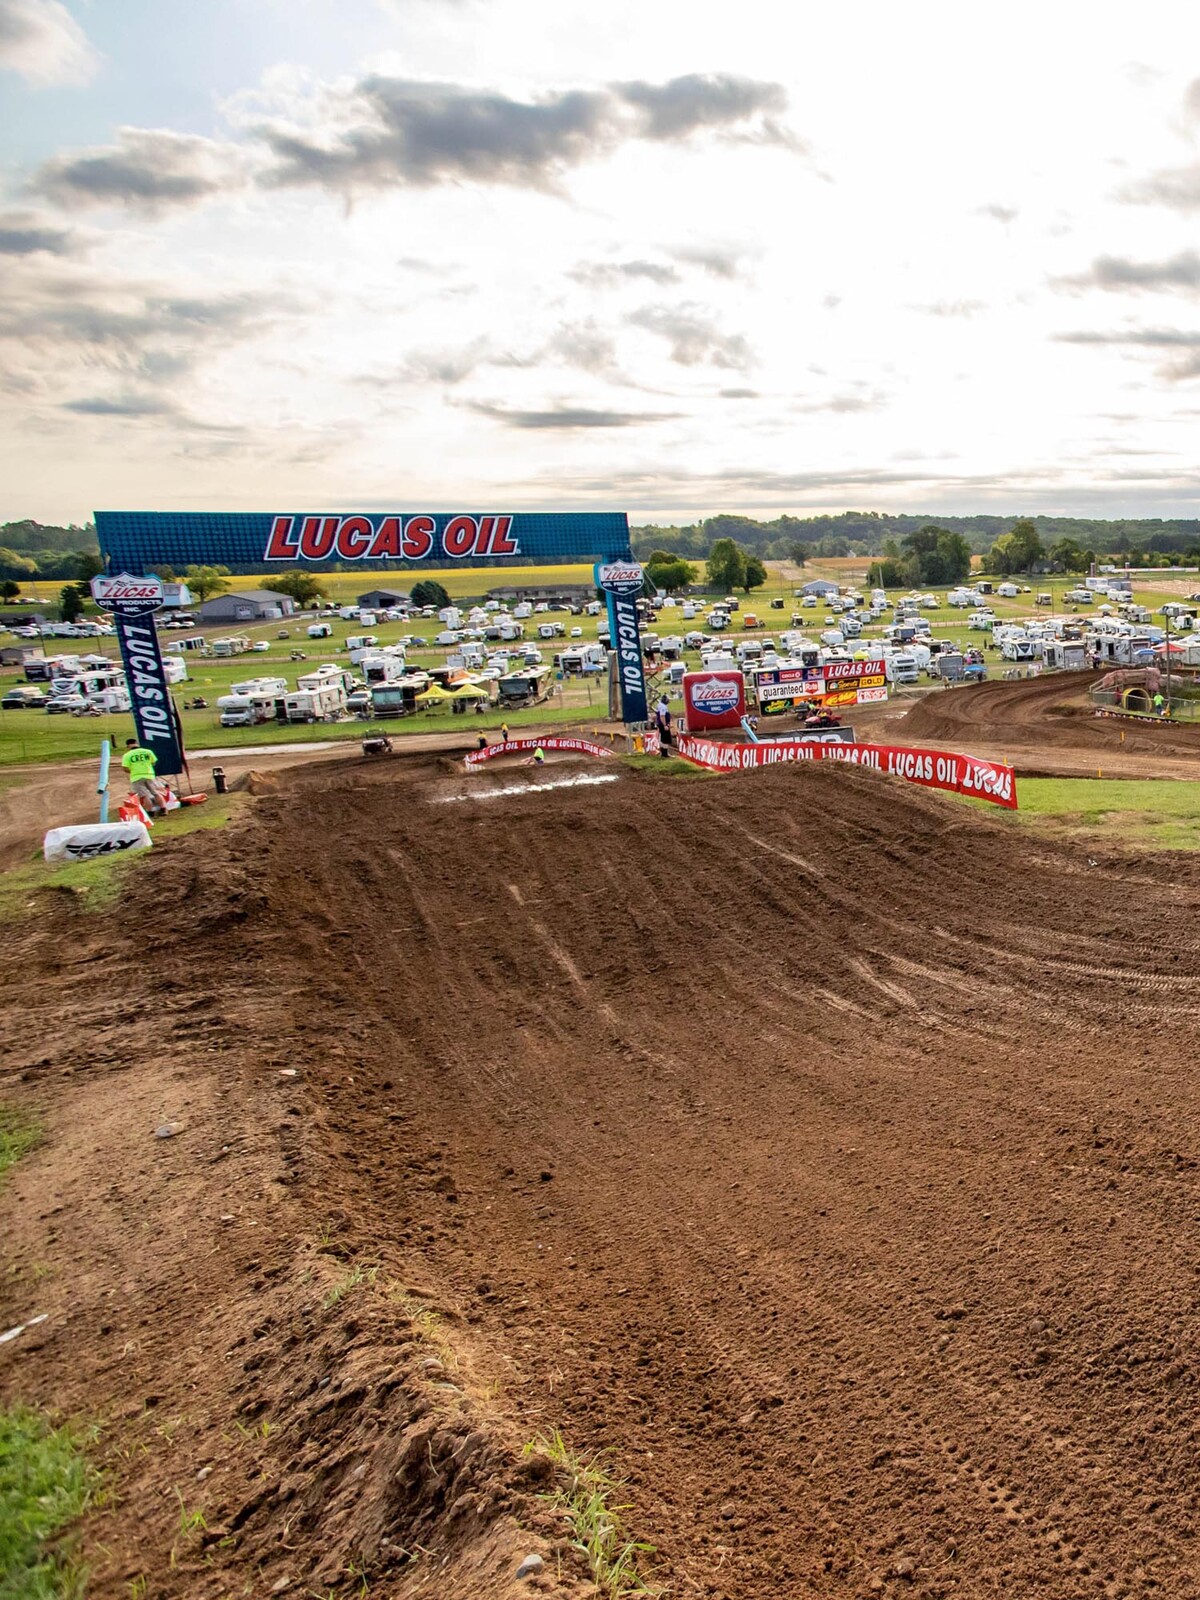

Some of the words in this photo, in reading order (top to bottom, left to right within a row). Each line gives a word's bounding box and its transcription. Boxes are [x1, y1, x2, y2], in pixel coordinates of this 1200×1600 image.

[264, 516, 436, 560] LUCAS
[442, 515, 518, 557] OIL
[605, 570, 640, 580] LUCAS
[103, 587, 159, 598] LUCAS
[616, 601, 640, 662] LUCAS
[123, 625, 164, 701] LUCAS
[828, 664, 863, 678] LUCAS
[864, 662, 882, 674] OIL
[623, 666, 643, 694] OIL
[861, 677, 883, 686] GOLD
[698, 689, 735, 699] LUCAS
[763, 683, 804, 699] guaranteed
[140, 706, 172, 741] OIL
[505, 741, 518, 750] OIL
[521, 740, 546, 749] LUCAS
[547, 739, 557, 748] OIL
[559, 740, 575, 749] LUCAS
[131, 753, 151, 764] CREW
[719, 748, 740, 768] LUCAS
[742, 749, 758, 768] OIL
[763, 748, 794, 765] LUCAS
[861, 750, 882, 771] OIL
[888, 752, 933, 780] LUCAS
[936, 755, 958, 784] OIL
[962, 763, 1012, 800] LUCAS
